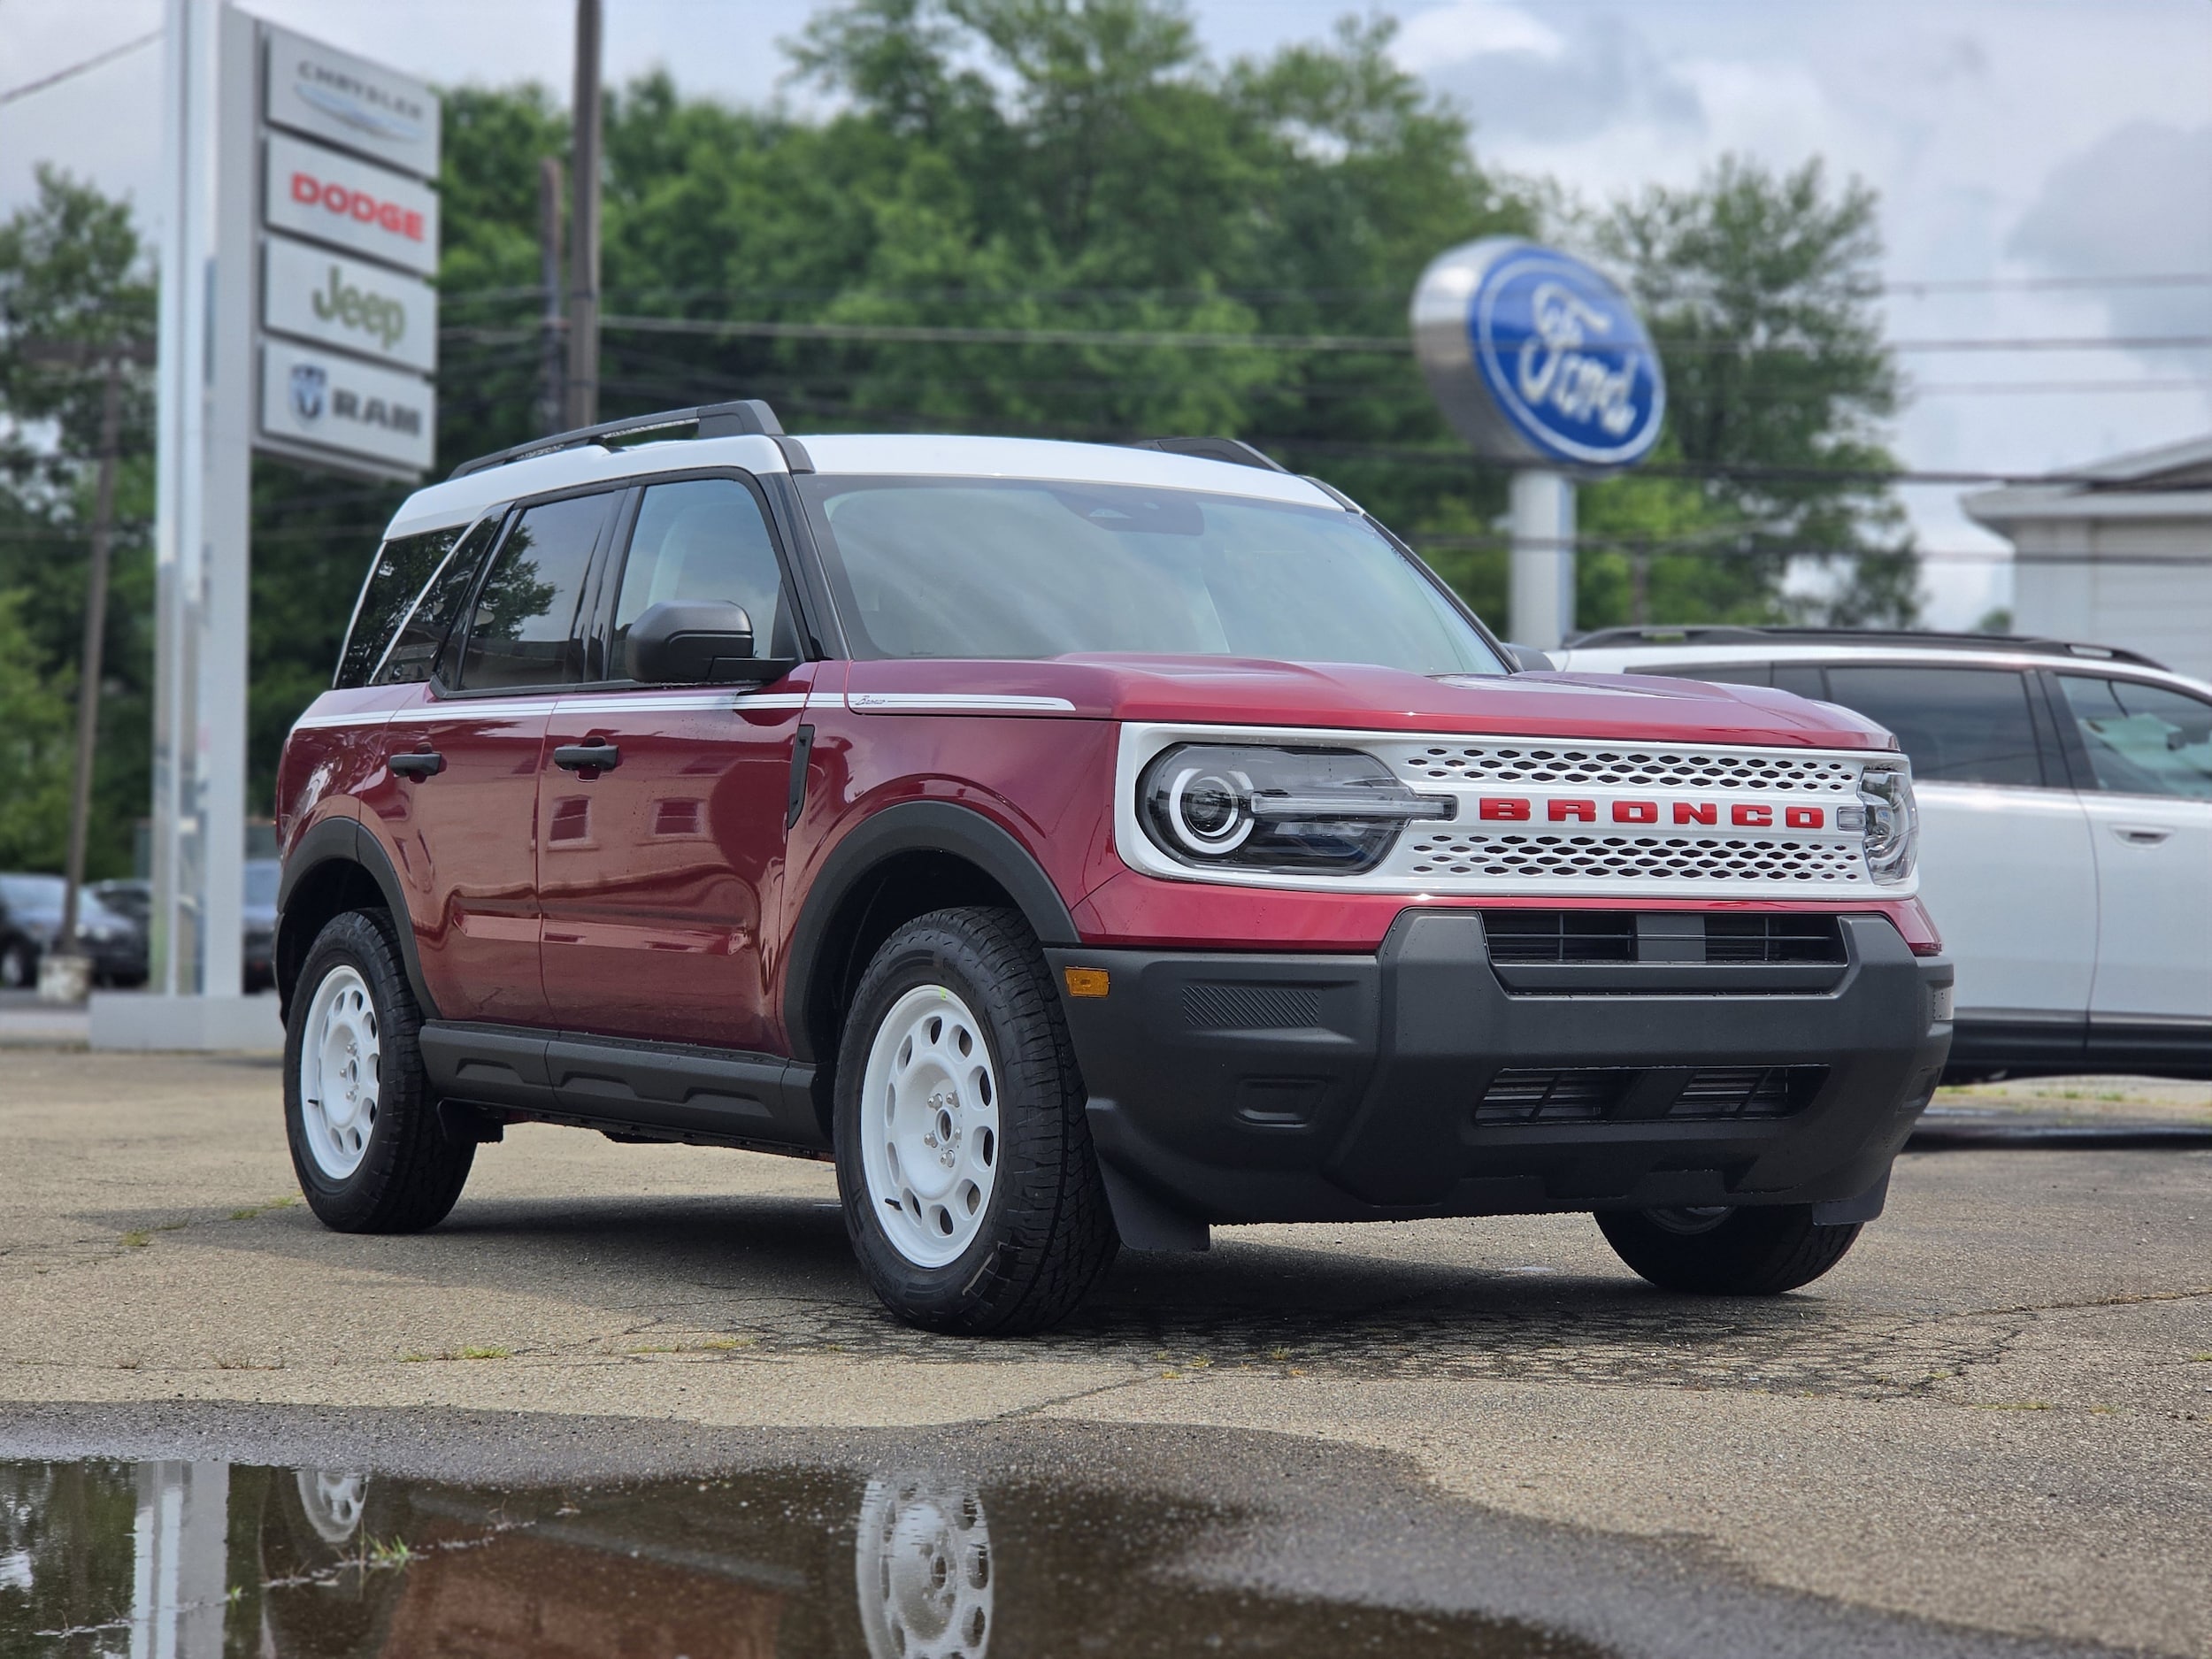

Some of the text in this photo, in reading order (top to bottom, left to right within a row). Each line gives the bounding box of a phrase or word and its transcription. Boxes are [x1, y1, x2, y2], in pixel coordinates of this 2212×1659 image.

[291, 171, 425, 242] DODGE
[313, 265, 404, 350] Jeep
[1517, 280, 1638, 436] Ford
[332, 387, 422, 436] RAM
[1479, 797, 1824, 829] BRONCO
